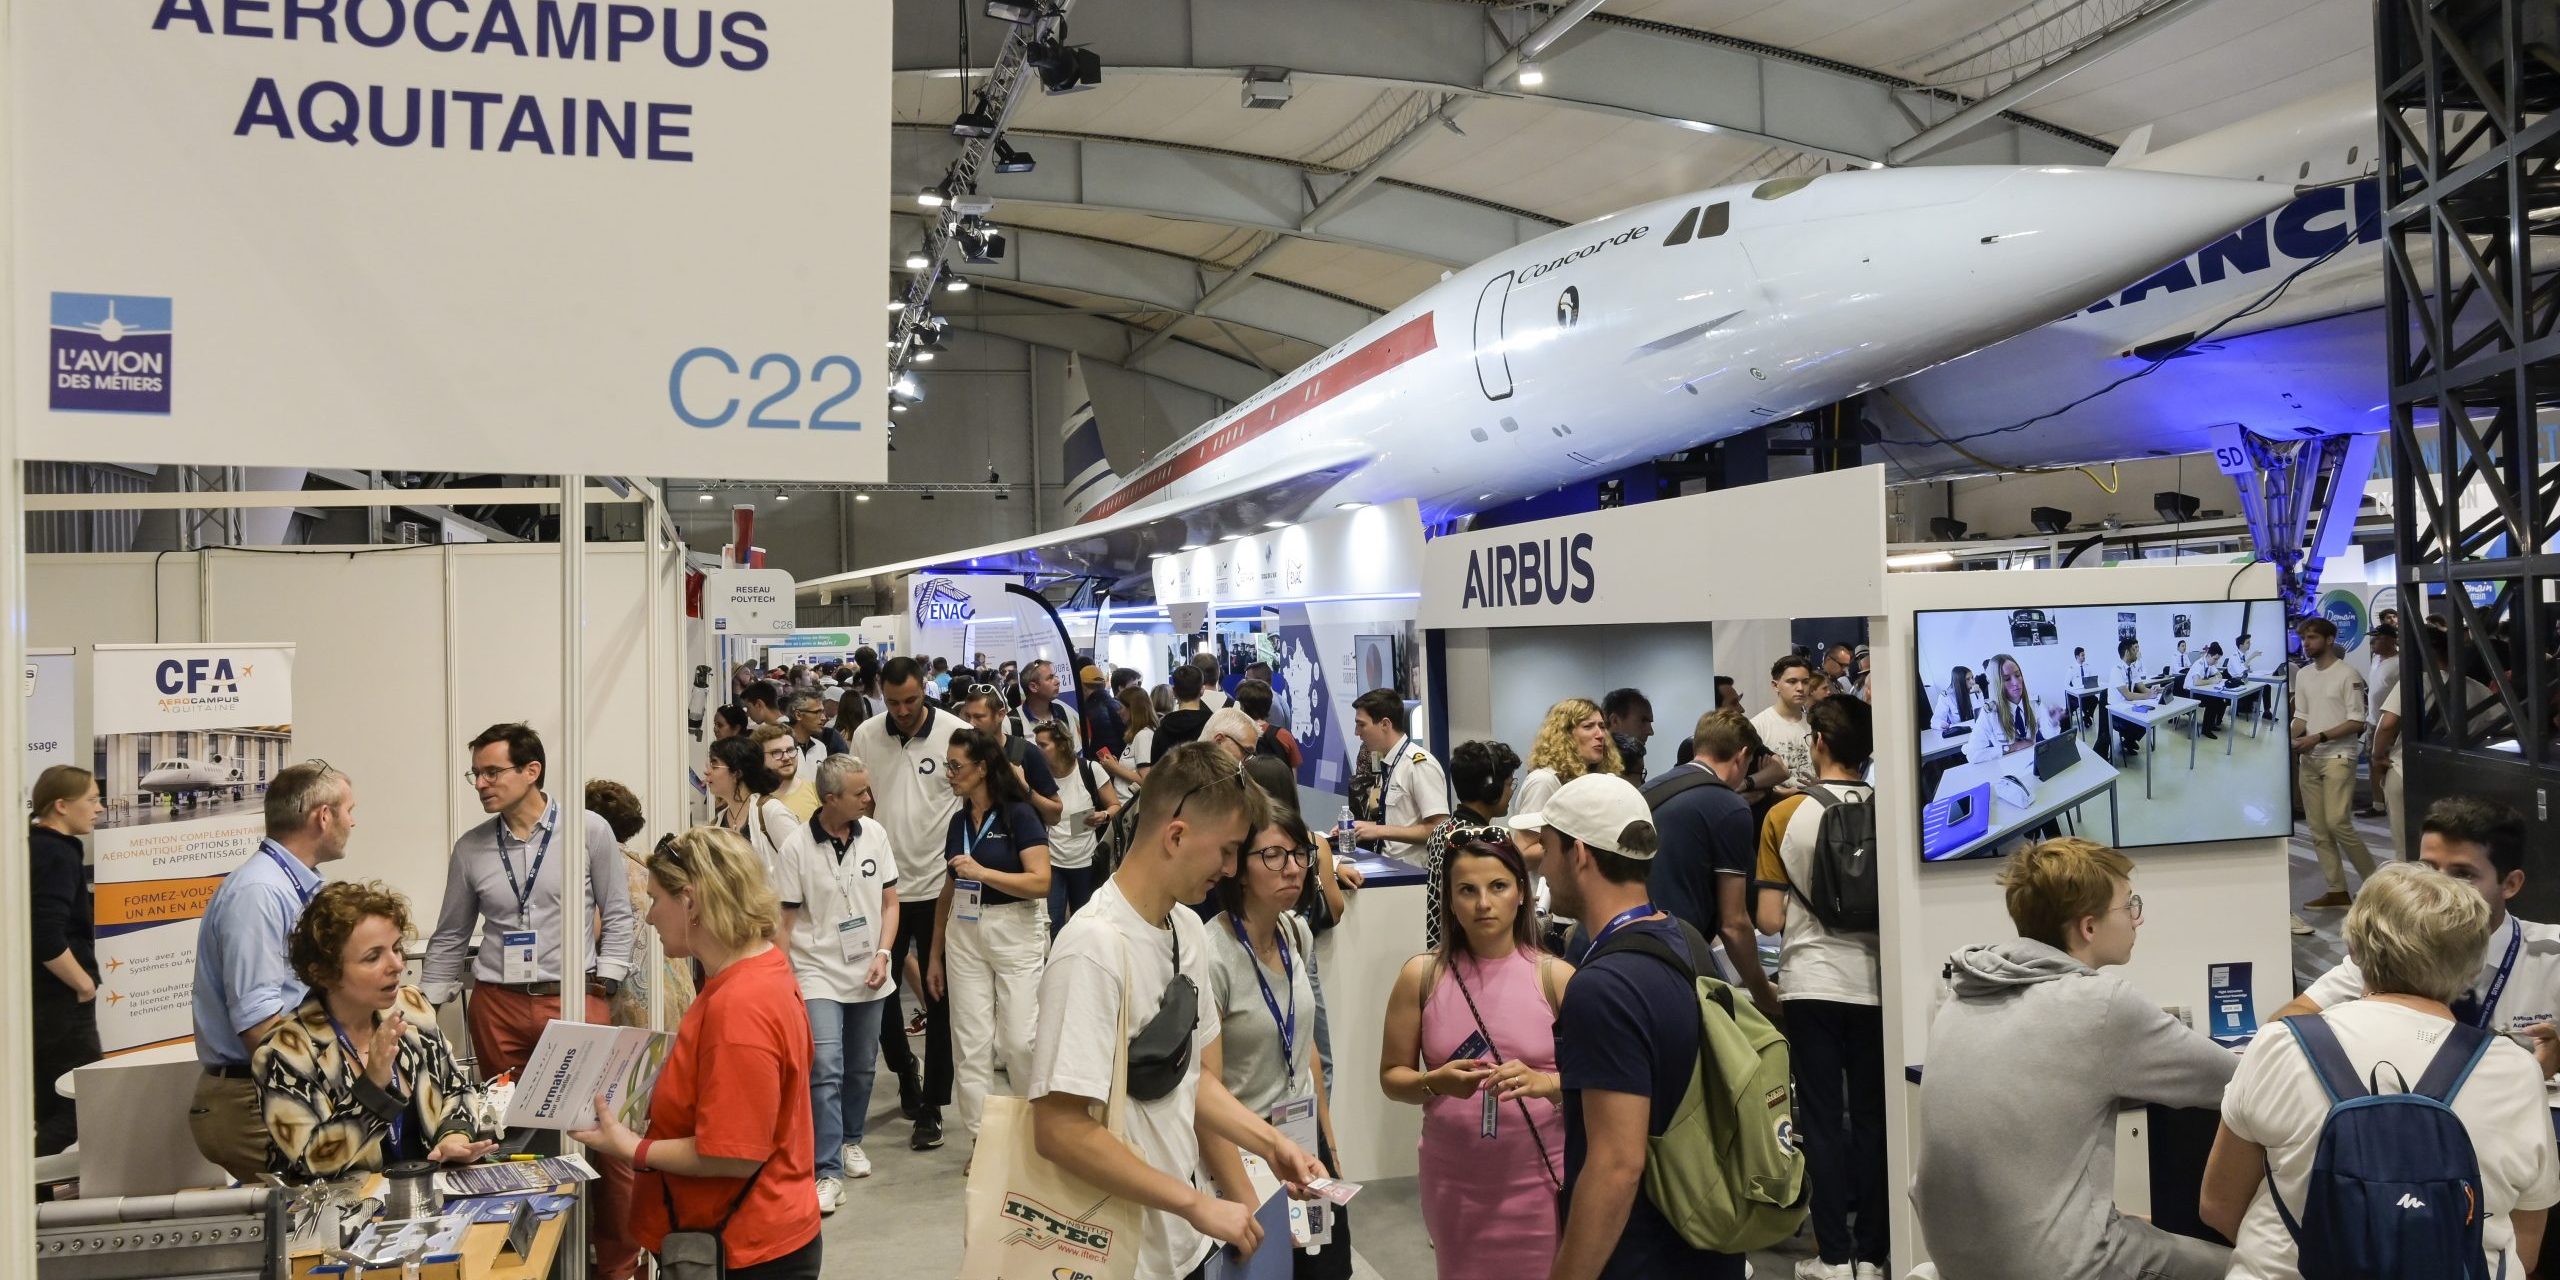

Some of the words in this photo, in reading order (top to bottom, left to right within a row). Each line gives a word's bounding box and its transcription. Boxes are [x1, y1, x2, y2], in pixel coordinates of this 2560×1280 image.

[152, 0, 769, 72] AEROCAMPUS
[234, 77, 693, 163] AQUITAINE
[1517, 225, 1649, 284] Concorde
[58, 348, 163, 374] L'AVION
[58, 373, 91, 389] DES
[94, 372, 162, 392] MÉTIERS
[668, 347, 862, 431] C22
[2217, 447, 2244, 467] SD
[1462, 532, 1595, 609] AIRBUS
[930, 603, 969, 620] ENAC
[772, 620, 793, 630] C26
[156, 658, 238, 695] CFA
[159, 697, 240, 706] AEROCAMPUS
[28, 740, 58, 753] ssage
[129, 835, 178, 847] MENTION
[186, 838, 230, 852] OPTIONS
[152, 858, 166, 866] EN
[169, 848, 247, 865] APPRENTISSAGE
[124, 886, 214, 907] FORMEZ-VOUS
[126, 910, 144, 920] UN
[147, 907, 166, 917] AN
[170, 902, 186, 913] EN
[129, 957, 150, 965] Vous
[155, 952, 175, 961] avez
[129, 1003, 174, 1017] technicien
[140, 995, 170, 1006] licence
[535, 1047, 577, 1119] Formations
[1005, 1200, 1109, 1249] IFTEC
[1065, 1220, 1110, 1237] INSTITUT
[1057, 1243, 1107, 1264] www.iftec.fr
